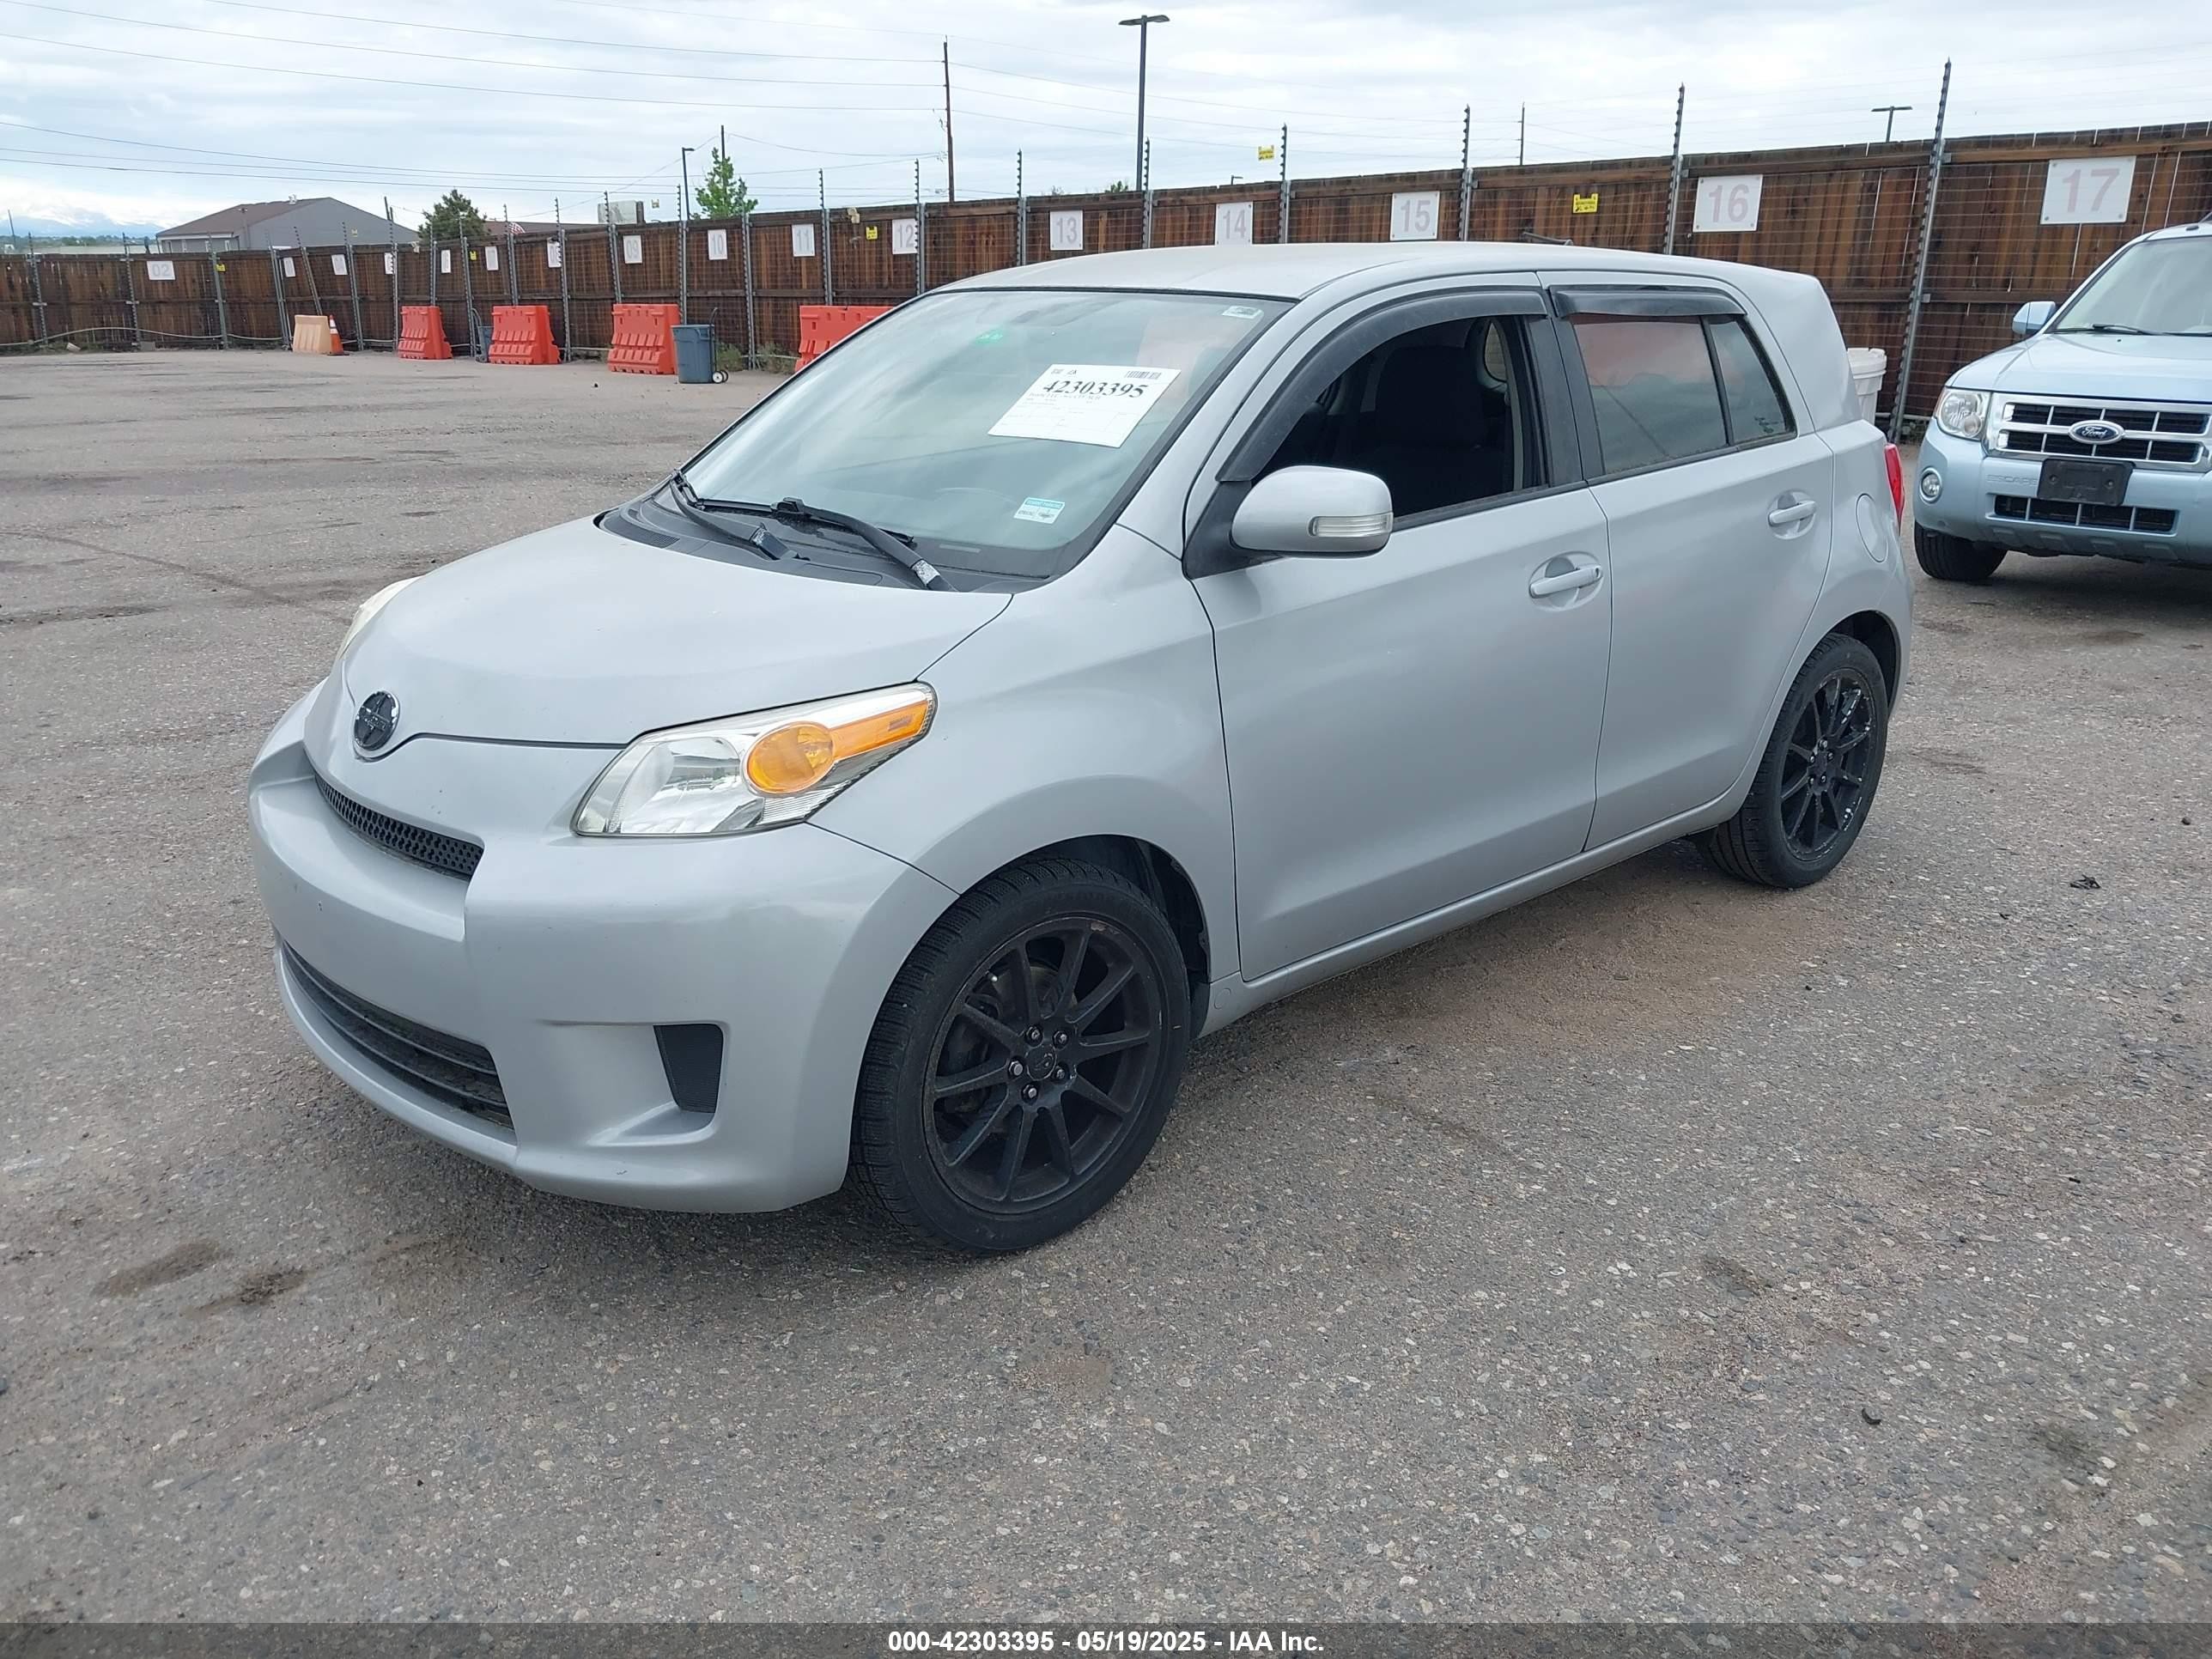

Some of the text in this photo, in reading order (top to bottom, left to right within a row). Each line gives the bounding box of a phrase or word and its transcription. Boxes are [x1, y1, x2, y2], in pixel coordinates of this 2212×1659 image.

[2063, 167, 2120, 213] 17
[1401, 198, 1431, 233] 15
[1708, 184, 1750, 223] 16
[898, 223, 915, 248] 12
[1056, 216, 1078, 245] 13
[1223, 208, 1246, 240] 14
[626, 239, 639, 260] 09
[712, 233, 724, 256] 10
[797, 229, 810, 252] 11
[152, 263, 171, 276] 02
[1043, 380, 1149, 398] 42303395
[2081, 426, 2107, 438] Ford
